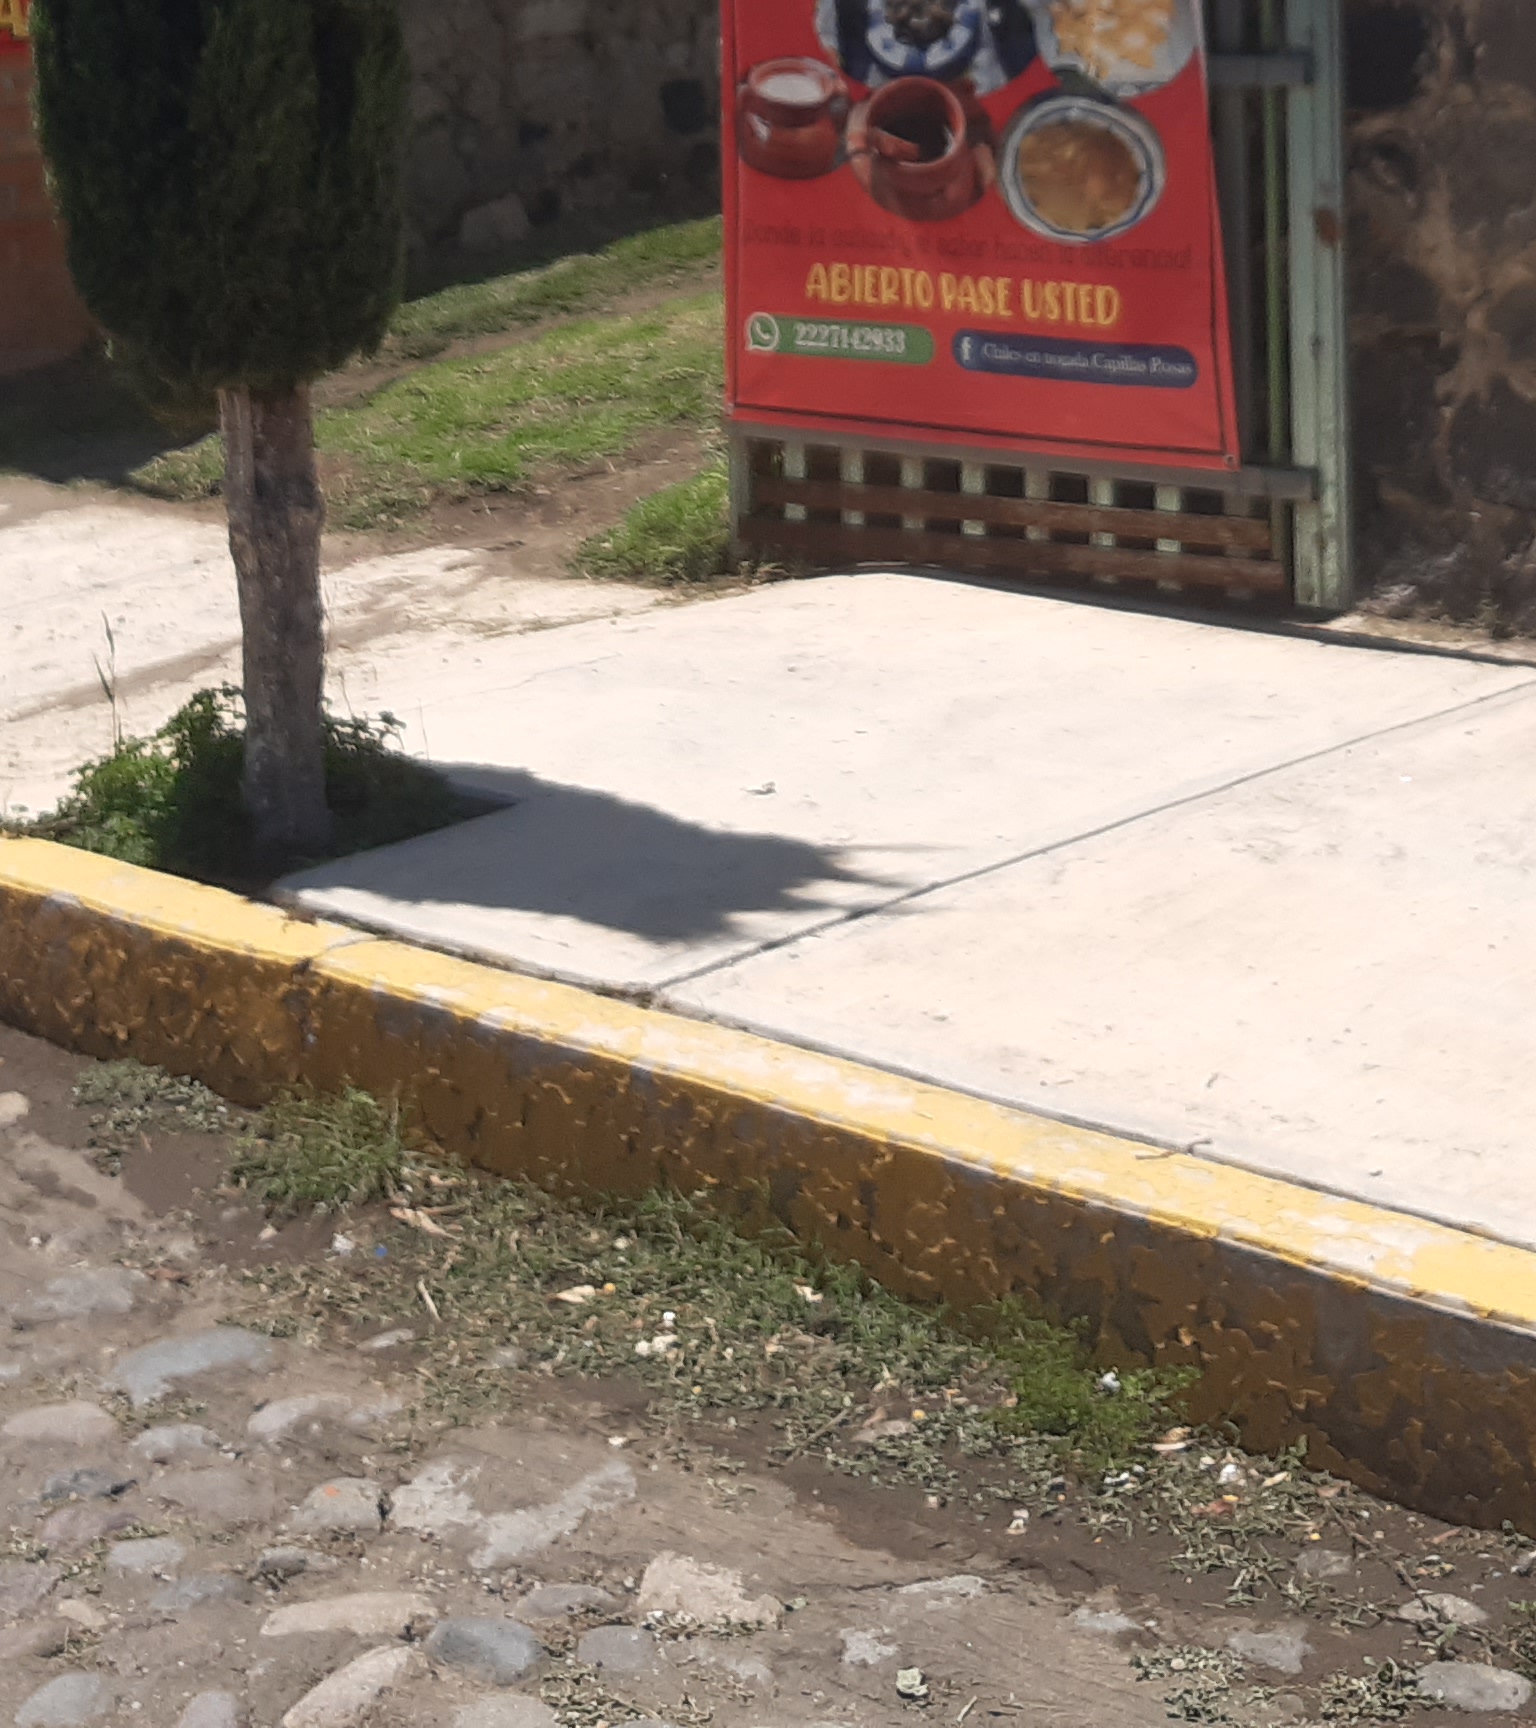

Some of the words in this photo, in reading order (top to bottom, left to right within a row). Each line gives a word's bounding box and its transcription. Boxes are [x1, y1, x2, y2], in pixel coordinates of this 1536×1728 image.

[806, 262, 935, 309] ABIERTO
[939, 272, 1013, 317] PASE
[1021, 278, 1120, 326] USTED
